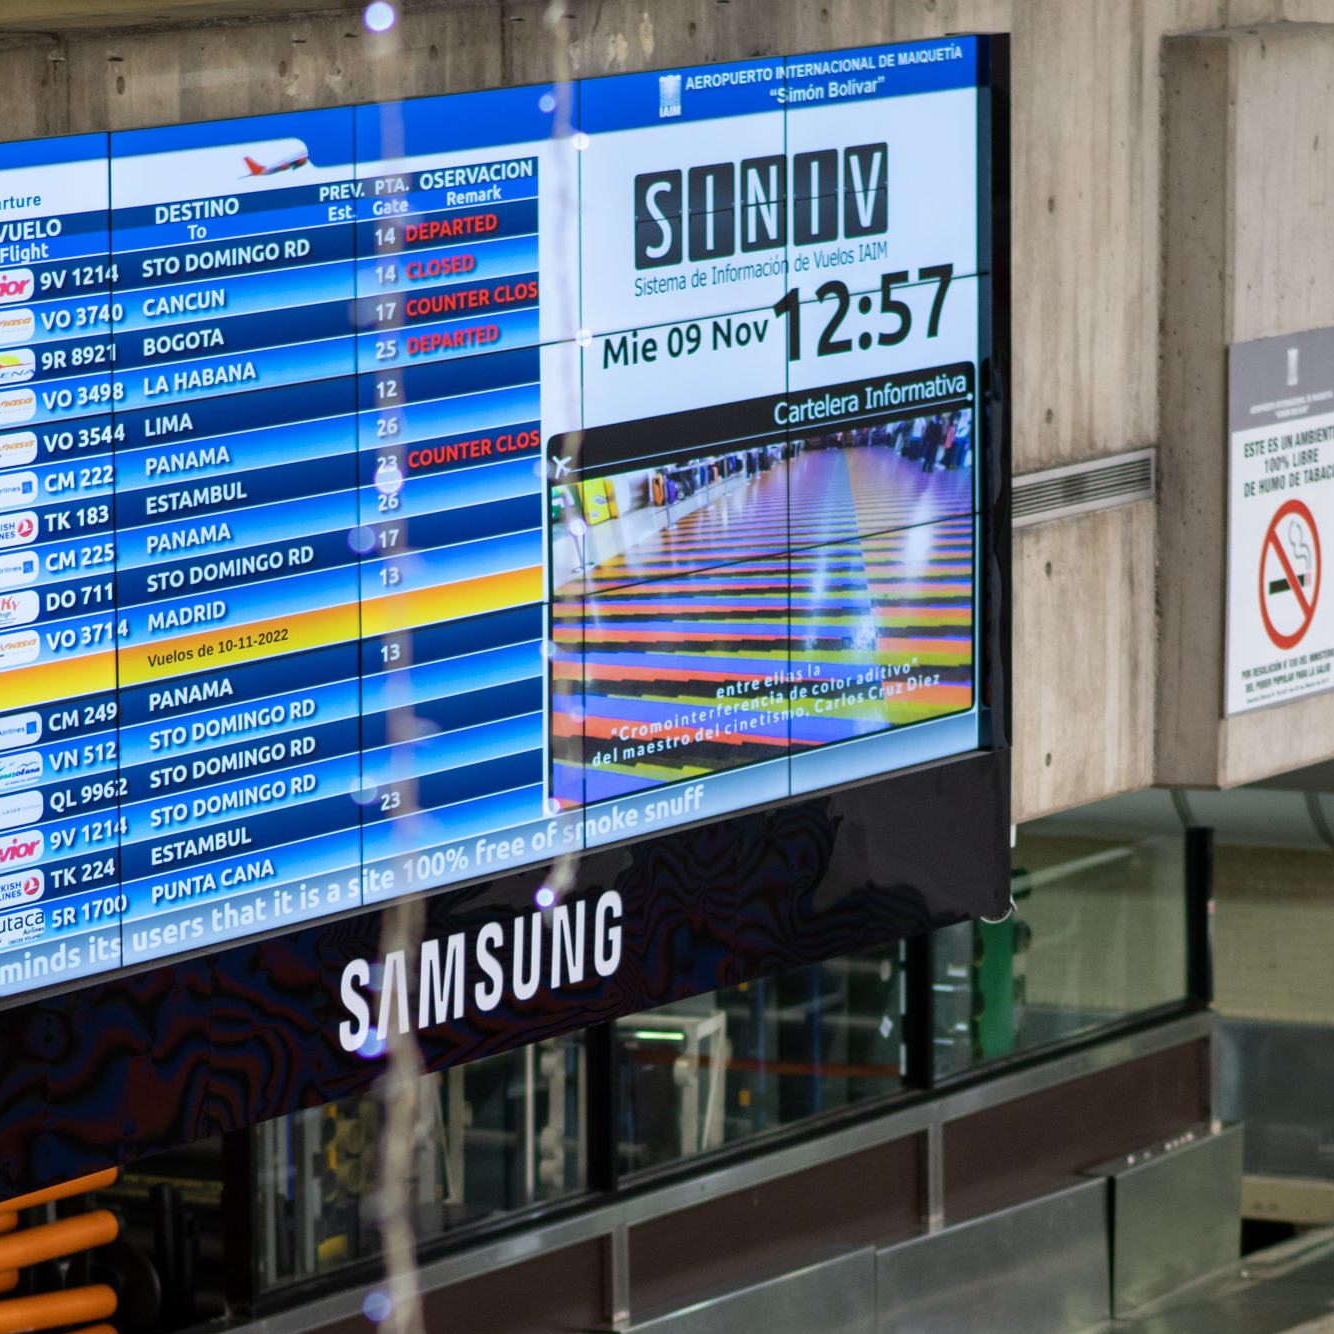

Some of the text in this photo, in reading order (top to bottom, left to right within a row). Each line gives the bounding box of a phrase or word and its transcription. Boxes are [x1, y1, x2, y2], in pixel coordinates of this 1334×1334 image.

[686, 68, 773, 90] AEROPUERTO
[774, 54, 877, 85] INTERNACIONAL
[879, 54, 895, 68] DE
[659, 105, 682, 118] IAIM
[0, 243, 49, 263] Flight
[187, 225, 207, 240] To
[372, 197, 408, 215] Gate
[447, 184, 501, 206] Remark
[156, 198, 239, 224] DESTINO
[320, 183, 365, 202] PREV.
[375, 175, 409, 195] PTA.
[420, 160, 532, 190] OSERVACION
[644, 151, 883, 259] SINIV
[41, 270, 66, 290] 9V
[73, 265, 118, 286] 1214
[143, 257, 179, 277] STO
[186, 244, 279, 272] DOMINGO
[285, 240, 309, 258] RD
[374, 226, 396, 245] 14
[405, 214, 497, 242] DEPARTED
[635, 241, 887, 296] Sistema de Información de Vuelos IAIM
[41, 254, 474, 331] VO 3740 CANCUN 14 CLOSED
[604, 262, 955, 369] Mie 09 Nov 12:57
[42, 351, 66, 370] 9R
[72, 344, 115, 365] 8921
[144, 328, 224, 356] BOGOTA
[377, 303, 395, 321] 17
[406, 289, 489, 316] COUNTER
[42, 325, 498, 410] VO 3498 LA HABANA 25 DEPARTED
[775, 374, 965, 424] Cartelera Informativa
[44, 380, 397, 452] VO 3544 LIMA 12
[1244, 440, 1265, 458] ESTE
[1267, 437, 1278, 453] ES
[1281, 434, 1293, 450] UN
[44, 418, 397, 493] CM 222 PANAMA 26
[1244, 481, 1255, 497] DE
[1259, 475, 1286, 494] HUMO
[1289, 472, 1300, 488] DE
[1264, 448, 1318, 473] 100% LIBRE
[45, 512, 71, 532] TK
[77, 506, 108, 526] 183
[147, 482, 247, 514] ESTAMBUL
[46, 566, 398, 651] VO 3714 MADRID 13
[47, 546, 313, 611] DO 711 STO DOMINGO RD
[148, 629, 288, 667] Vuelos de 10-11-2022
[717, 664, 820, 699] entre ellas la
[49, 710, 79, 731] CM
[85, 702, 117, 724] 249
[150, 679, 233, 711] PANAMA
[592, 748, 617, 767] del
[623, 734, 691, 759] maestro
[695, 723, 719, 741] del
[814, 693, 865, 714] Carlos
[868, 683, 902, 700] Cruz
[907, 675, 940, 689] Diez
[790, 686, 807, 701] de
[812, 677, 851, 695] color
[49, 749, 77, 770] VN
[83, 741, 116, 764] 512
[149, 727, 186, 750] STO
[192, 706, 285, 741] DOMINGO
[290, 699, 315, 719] RD
[51, 790, 77, 812] QL
[81, 778, 127, 803] 9962
[52, 907, 75, 928] 5R
[82, 894, 127, 923] 1700
[152, 874, 216, 904] PUNTA
[221, 859, 274, 892] CANA
[89, 936, 122, 963] its
[132, 913, 202, 952] users
[210, 897, 268, 933] that
[273, 891, 293, 915] it
[296, 884, 320, 910] is
[325, 882, 340, 900] a
[346, 867, 395, 898] site
[402, 847, 469, 884] 100%
[474, 837, 526, 866] free
[531, 822, 559, 851] of
[563, 807, 638, 843] smoke
[644, 785, 705, 822] snuff
[339, 891, 623, 1053] SAMSUNG
